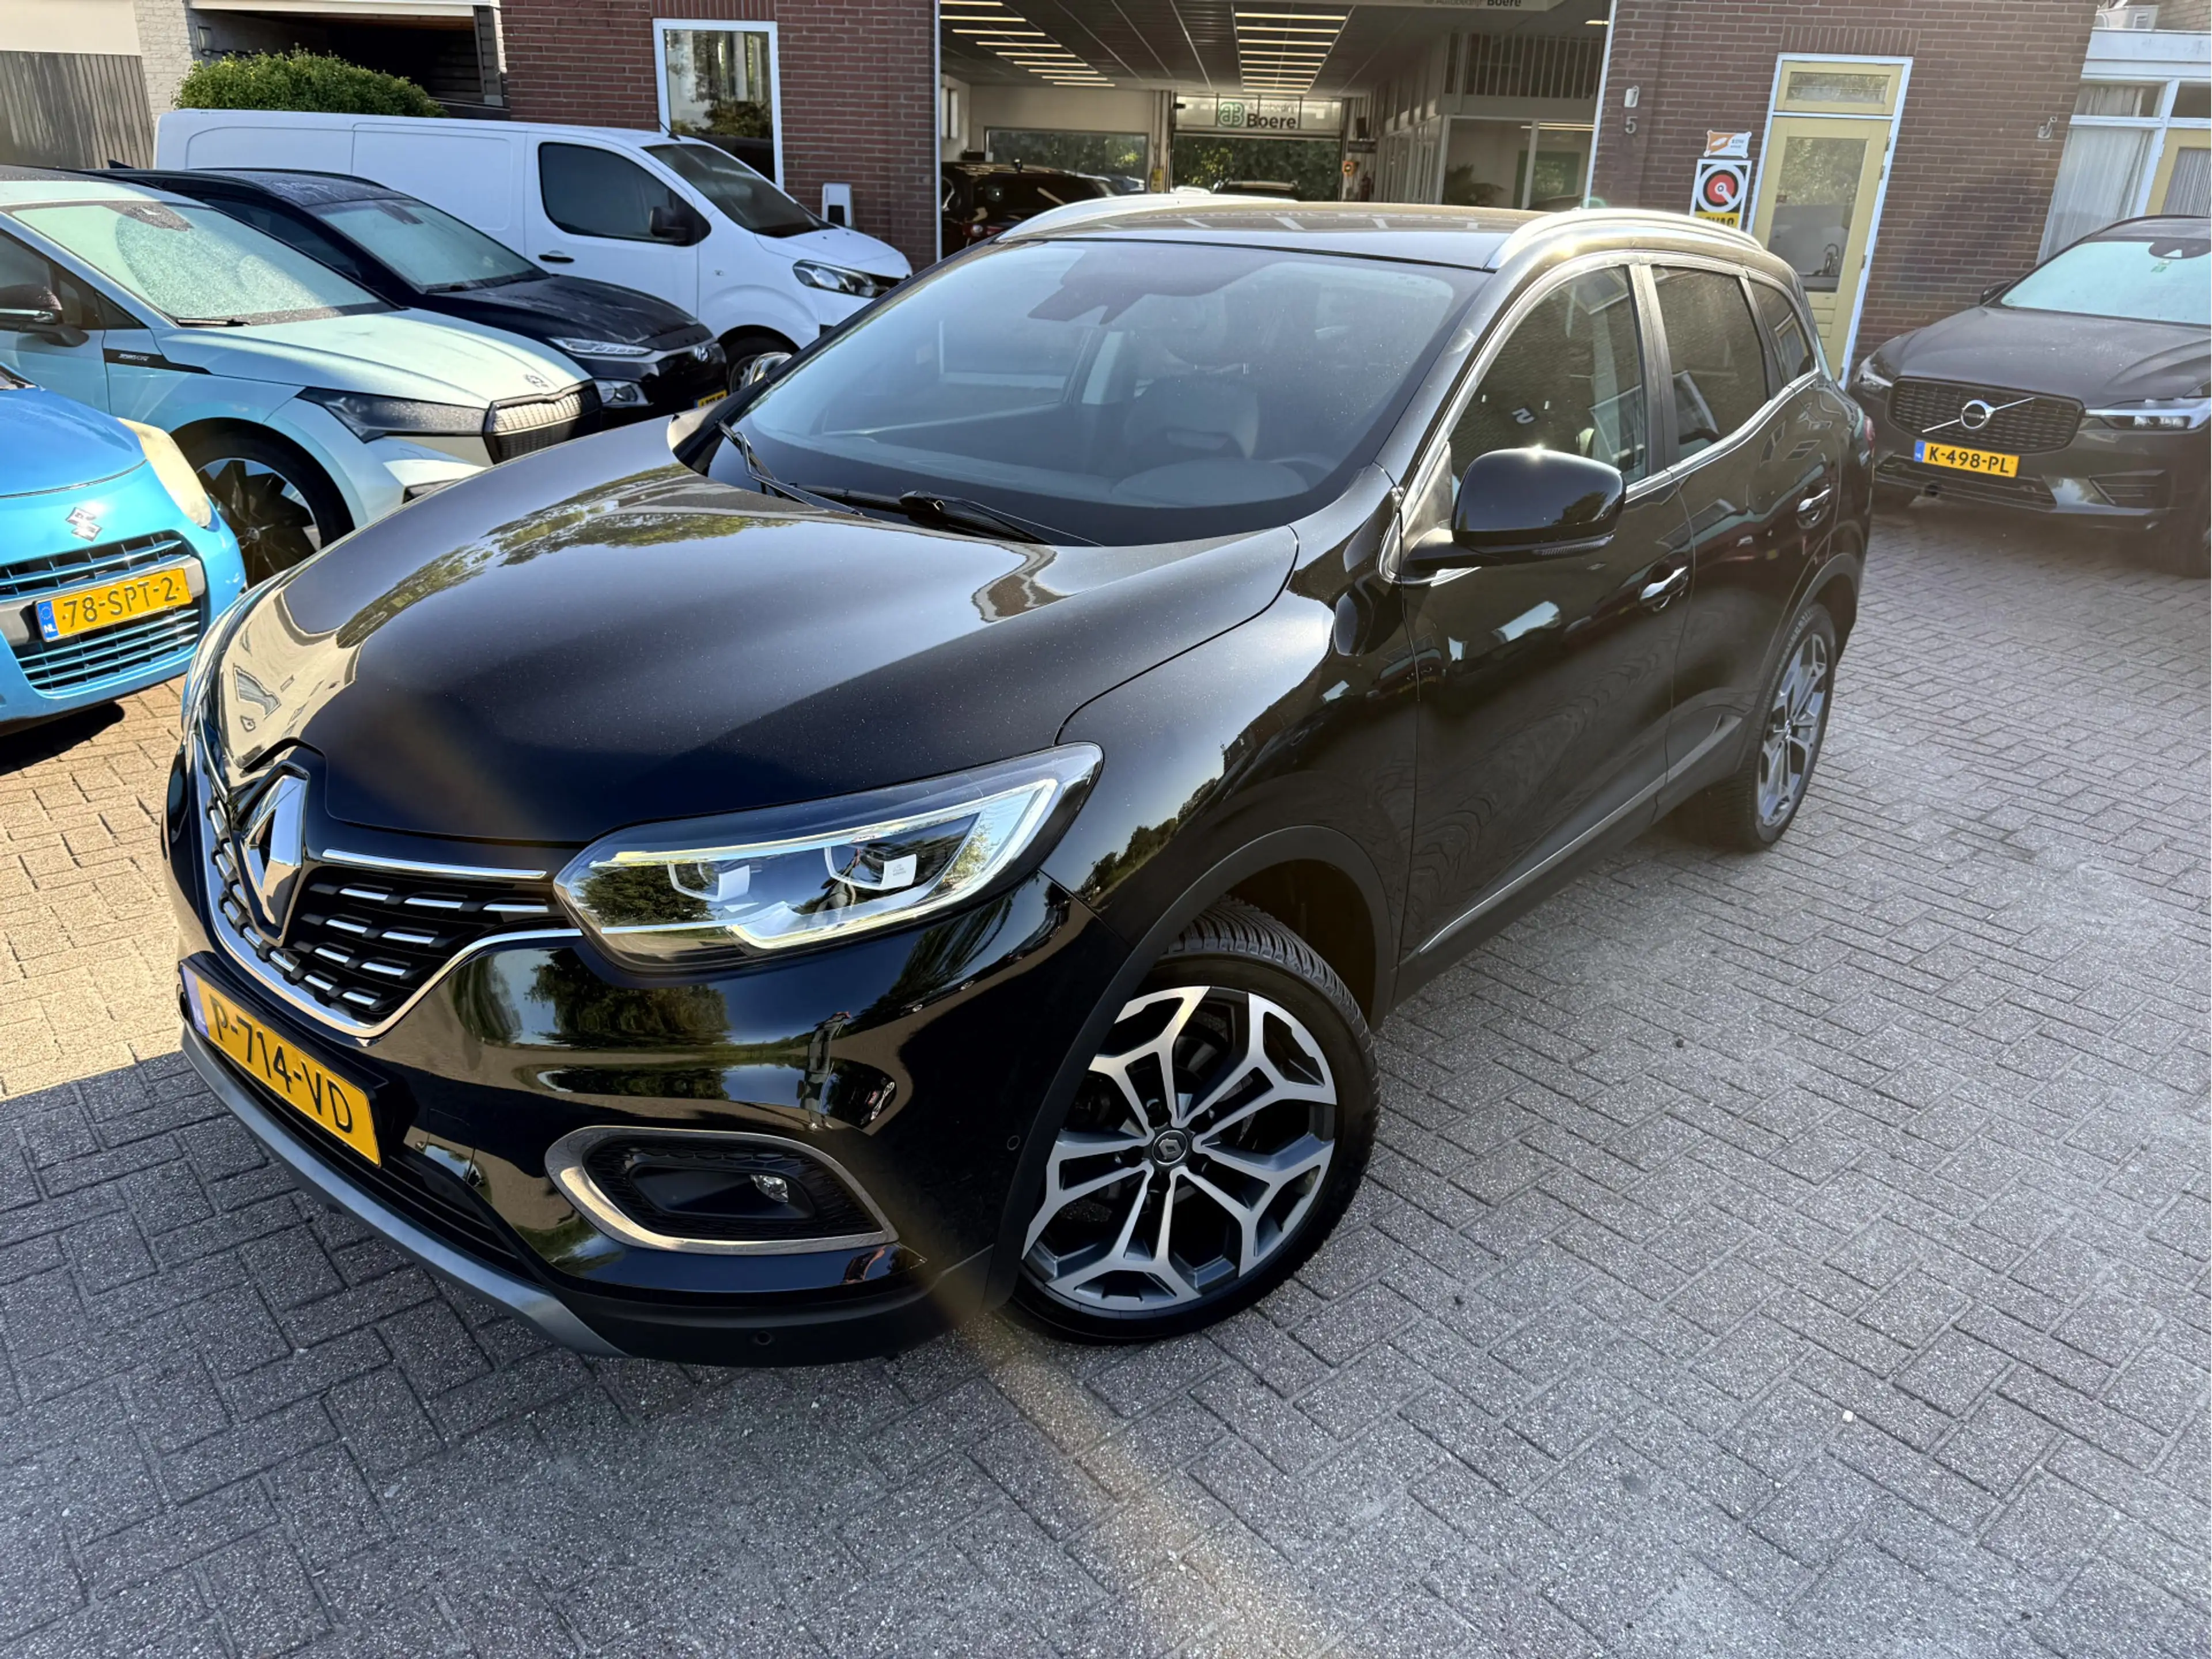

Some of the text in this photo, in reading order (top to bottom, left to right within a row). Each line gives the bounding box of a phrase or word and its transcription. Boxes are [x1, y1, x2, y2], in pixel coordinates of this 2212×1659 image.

[1248, 114, 1296, 128] Boere
[1625, 116, 1638, 134] 5
[1929, 446, 2009, 474] K-498-PL
[63, 577, 177, 627] 78-SPT-2
[44, 623, 57, 634] NL
[209, 994, 353, 1134] P-714-VD
